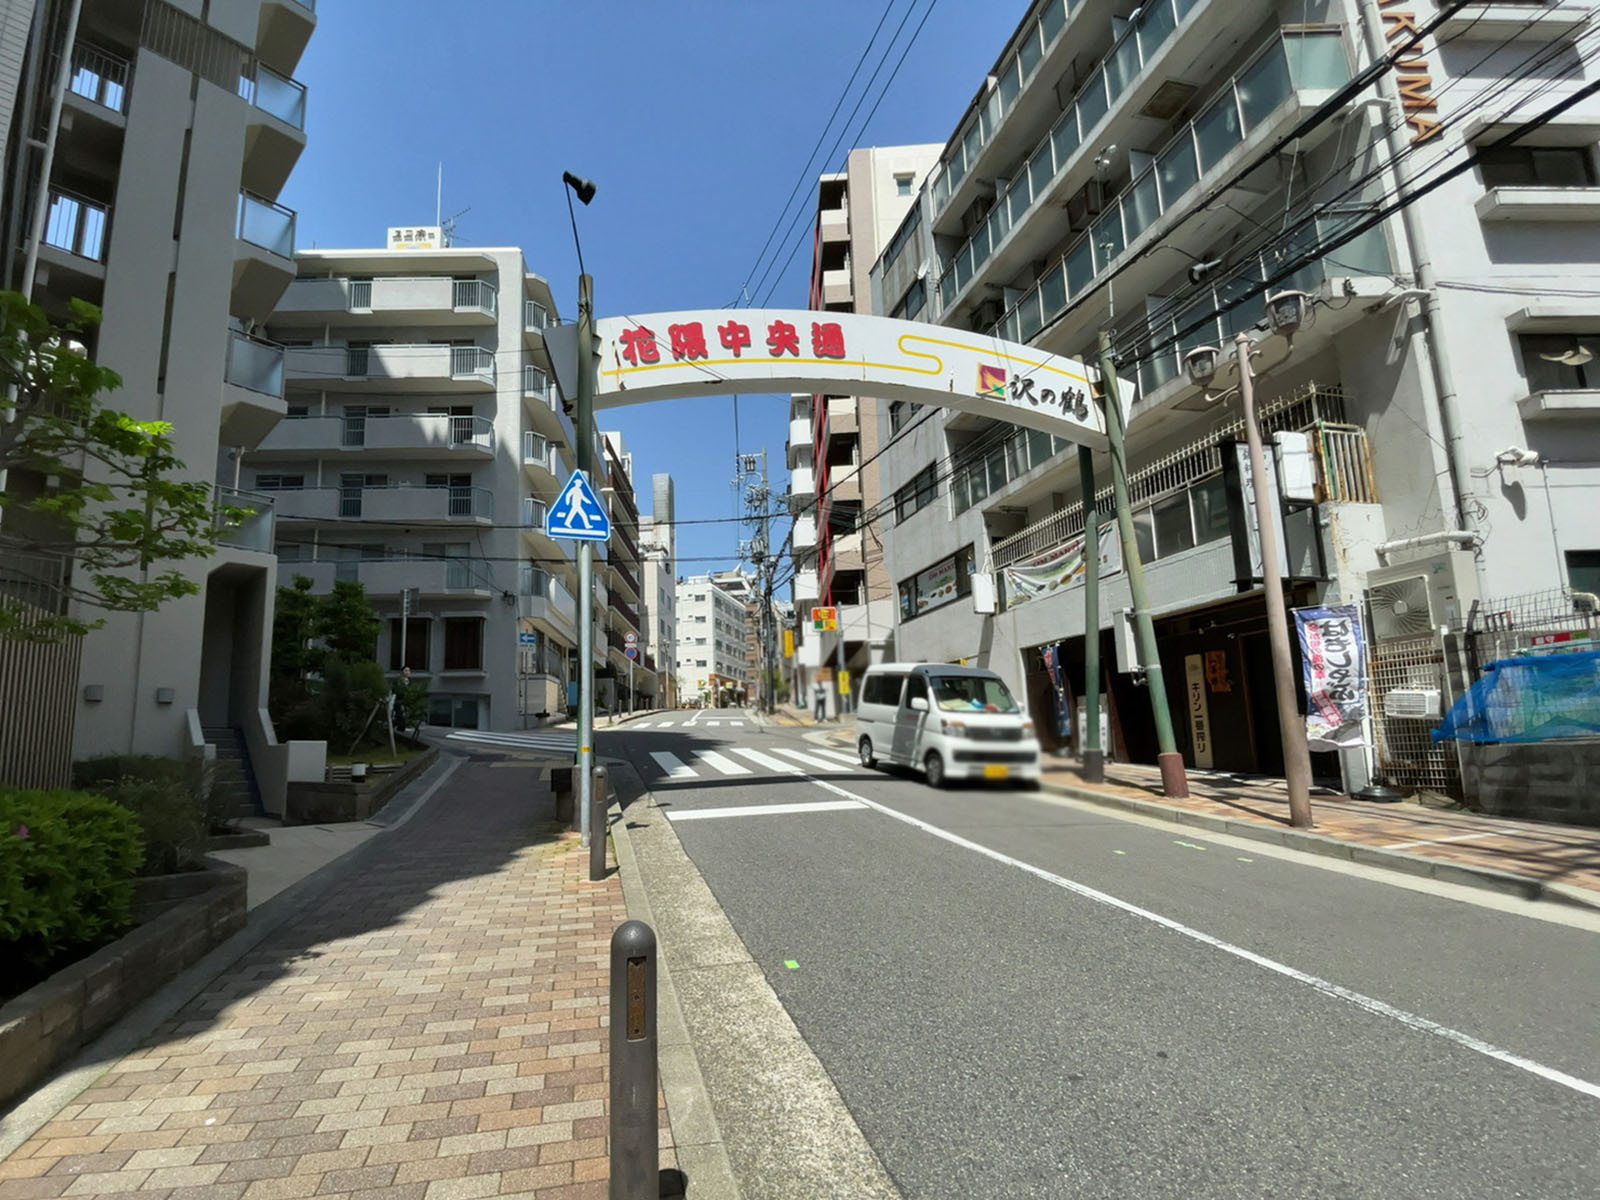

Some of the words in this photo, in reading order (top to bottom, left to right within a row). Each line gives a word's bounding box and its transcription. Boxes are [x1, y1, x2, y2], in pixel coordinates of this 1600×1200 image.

[1377, 0, 1443, 146] KUMA
[618, 320, 847, 367] 花隈中央通
[1009, 373, 1089, 422] 沢の鶴
